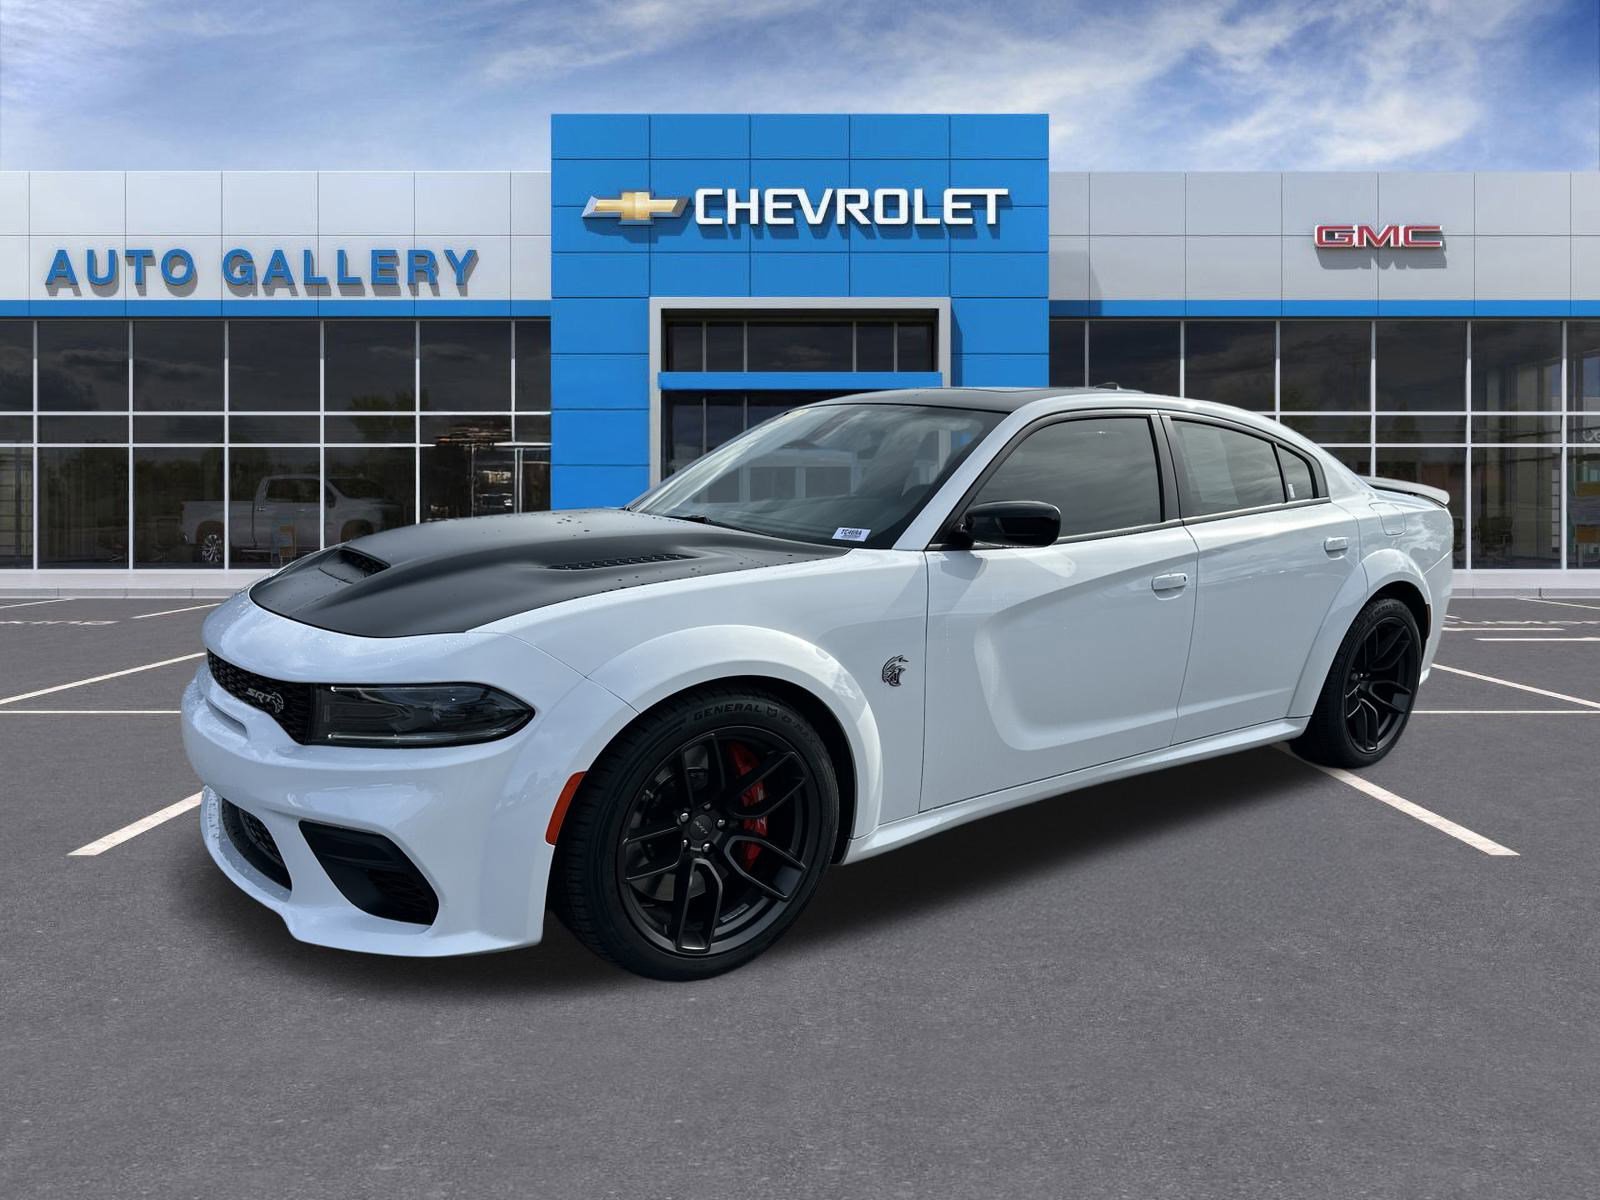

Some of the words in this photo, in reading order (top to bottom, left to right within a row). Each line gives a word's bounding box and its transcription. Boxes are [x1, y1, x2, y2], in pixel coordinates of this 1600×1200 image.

[695, 188, 1008, 225] CHEVROLET
[1315, 224, 1442, 248] GMC
[46, 248, 196, 285] AUTO
[222, 248, 476, 285] GALLERY
[246, 687, 273, 704] SRT
[694, 703, 762, 721] GENERAL
